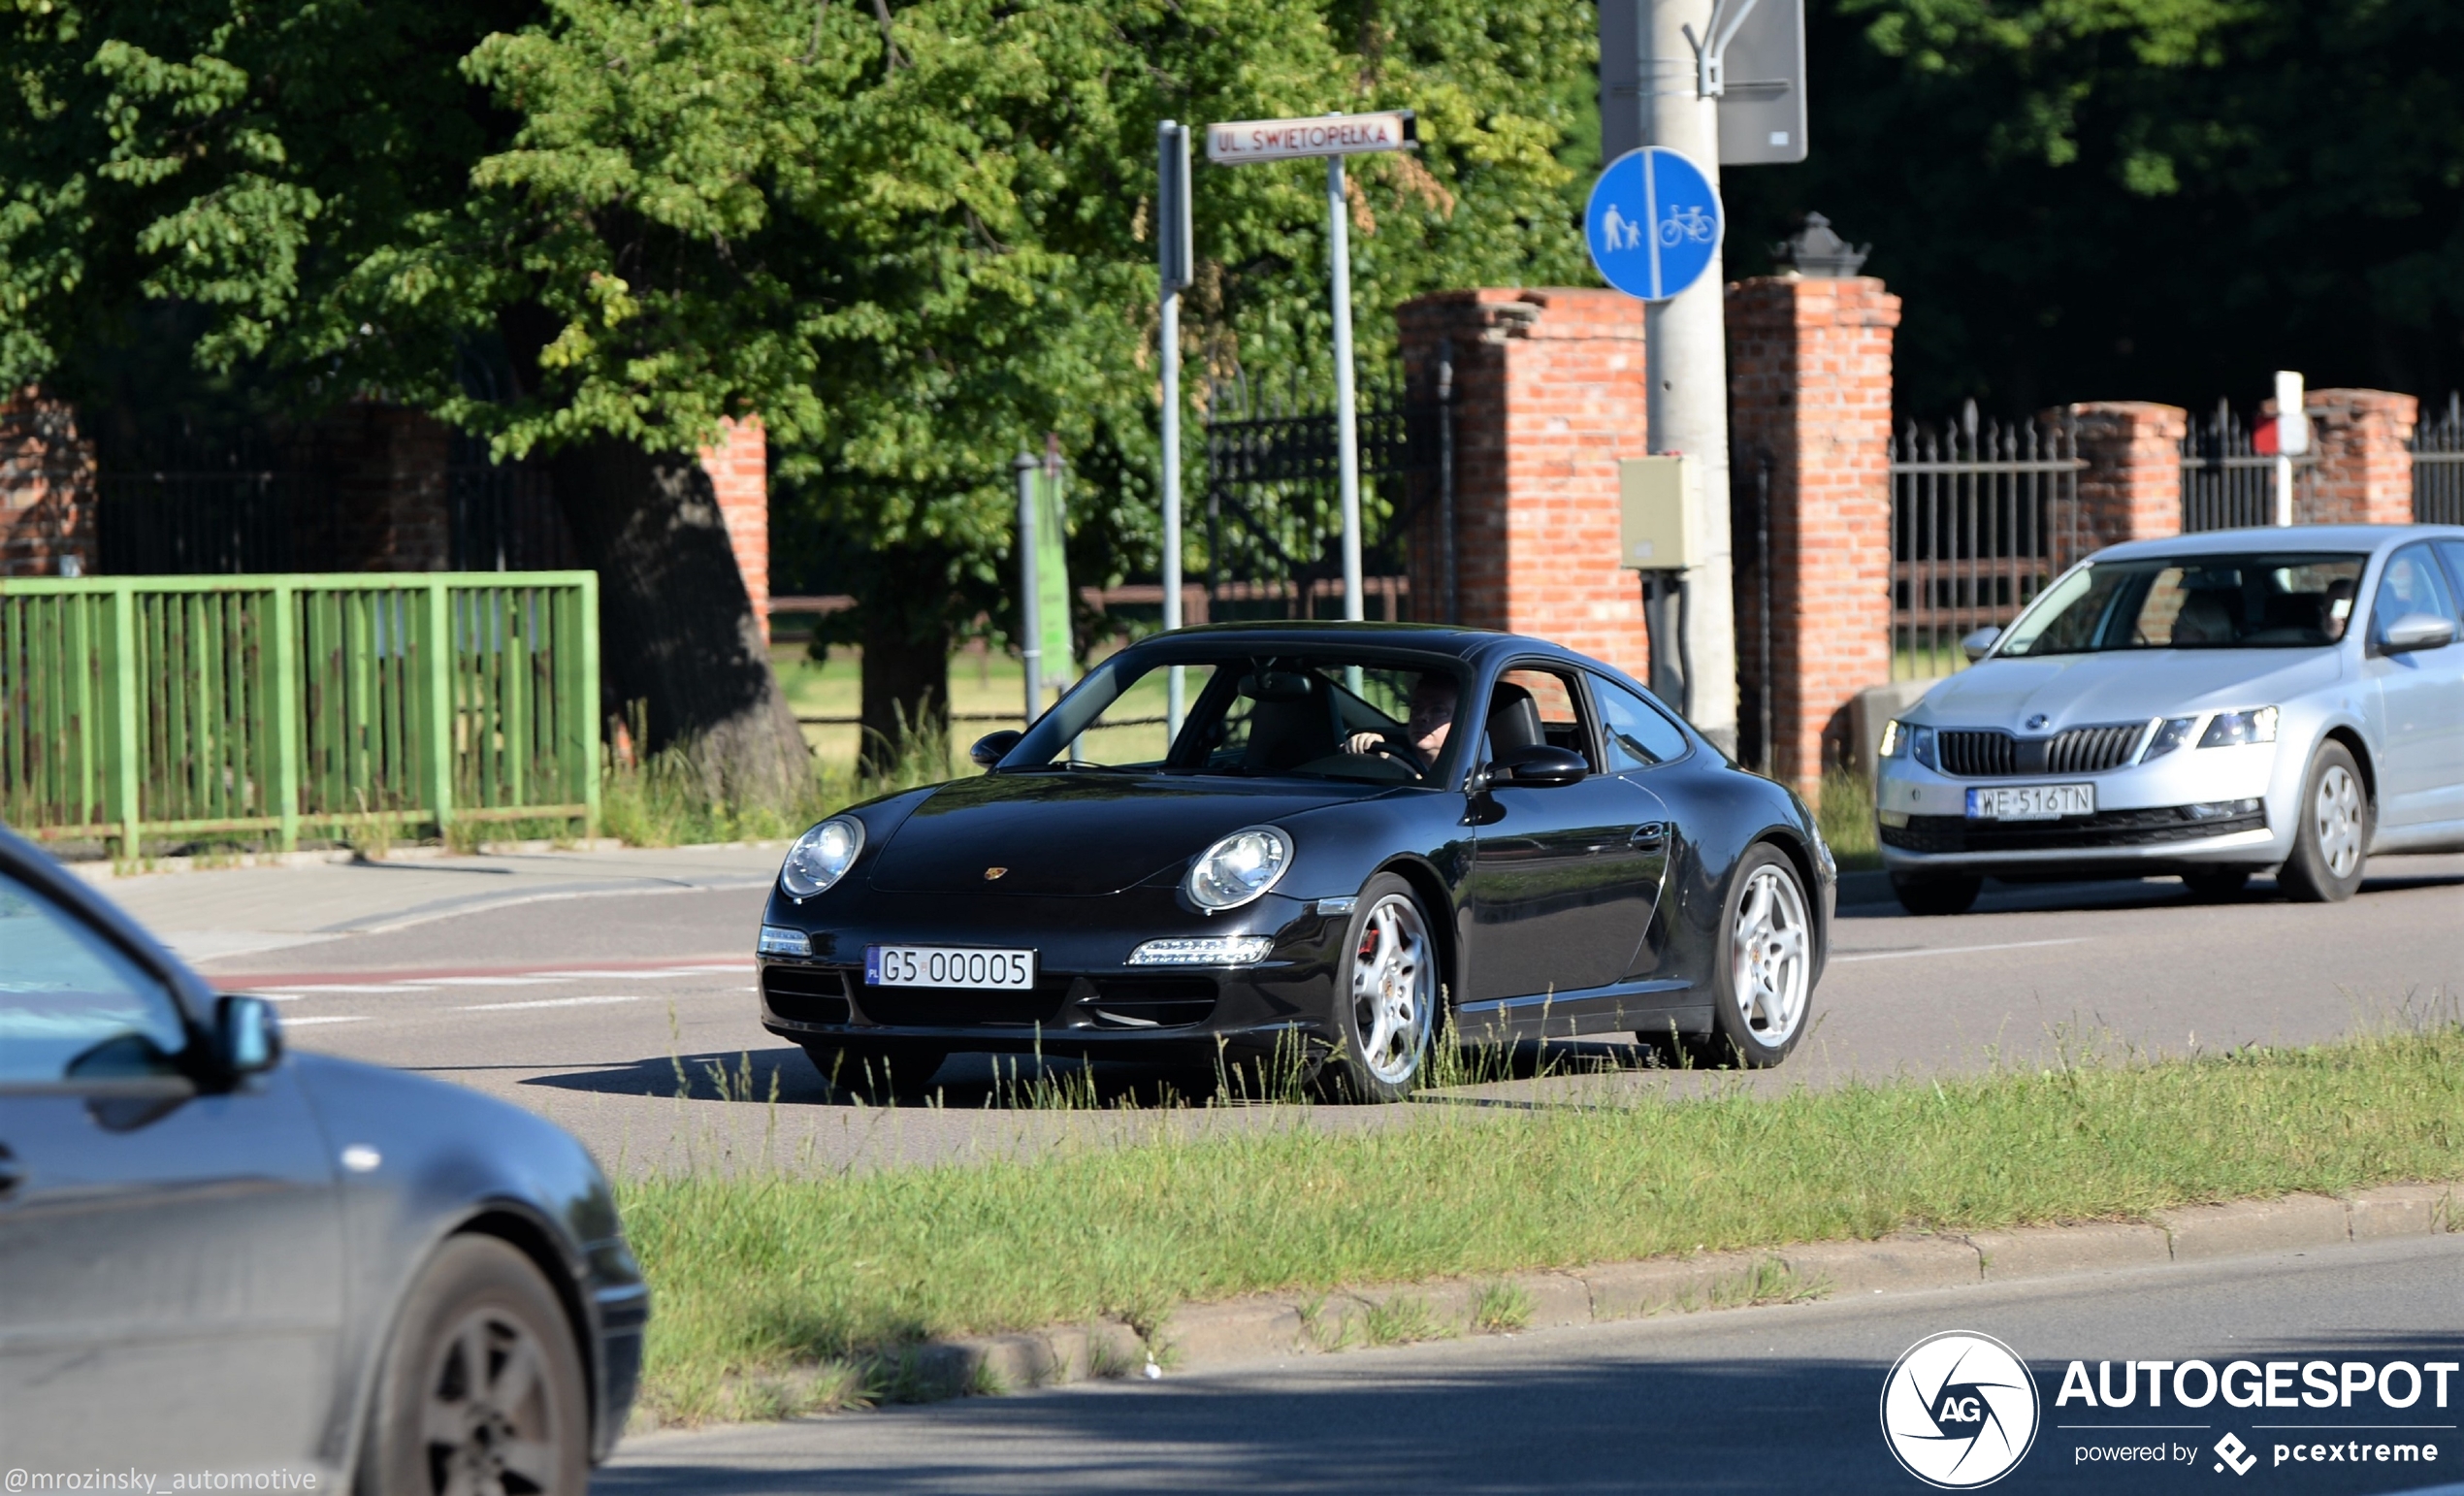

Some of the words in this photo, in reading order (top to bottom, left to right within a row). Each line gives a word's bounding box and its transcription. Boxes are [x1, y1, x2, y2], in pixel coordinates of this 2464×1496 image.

[1217, 130, 1246, 152] UL.
[1982, 790, 2010, 815] WE
[2019, 787, 2090, 813] 516TN
[868, 969, 879, 978] PL
[885, 951, 917, 982] G5
[929, 952, 1026, 985] 00005
